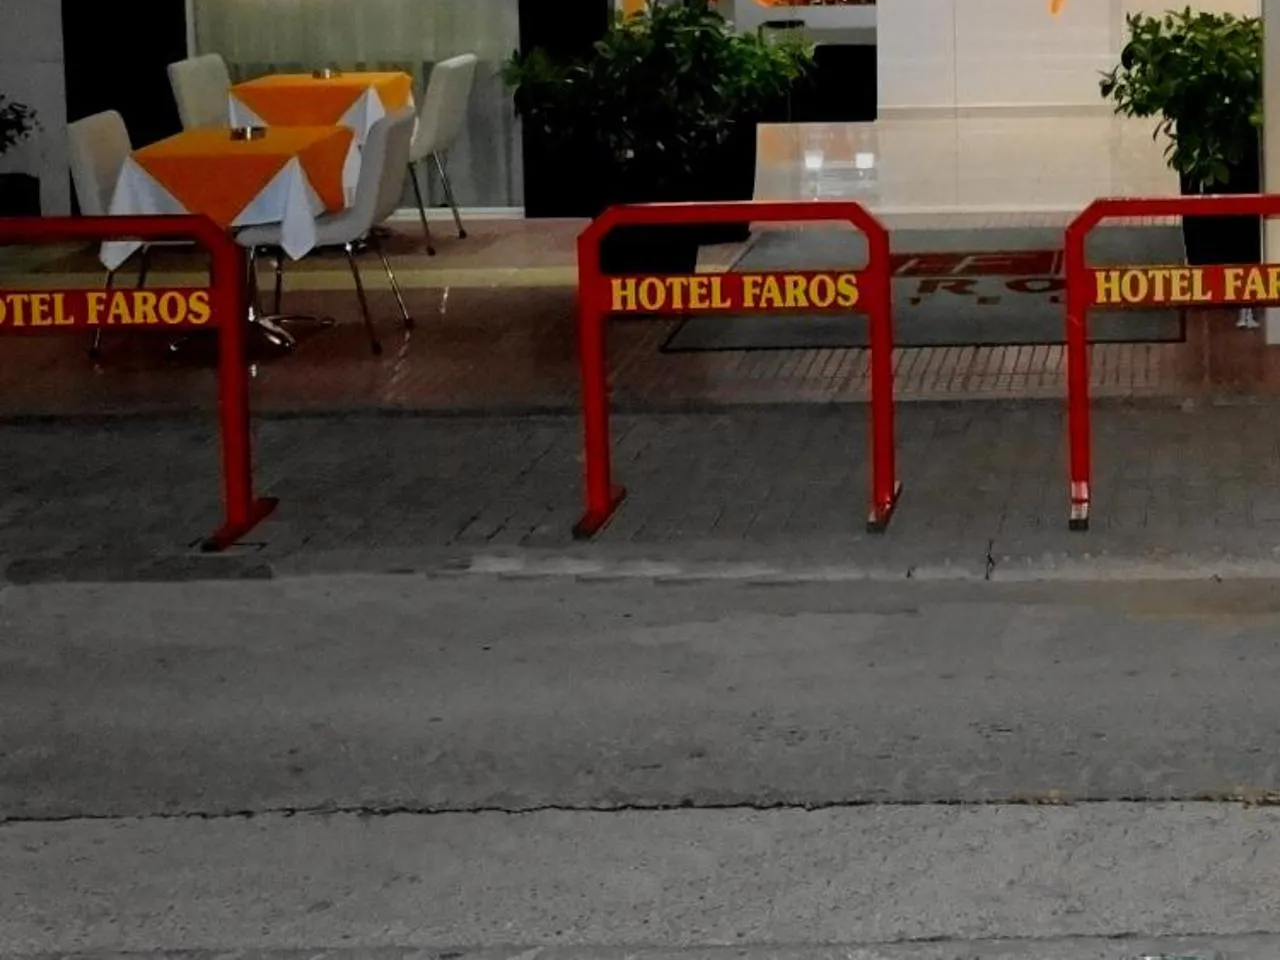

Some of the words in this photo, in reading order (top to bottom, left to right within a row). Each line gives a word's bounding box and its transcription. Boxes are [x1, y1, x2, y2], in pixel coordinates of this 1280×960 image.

[610, 276, 731, 310] HOTEL
[742, 273, 859, 308] FAROS
[1095, 269, 1212, 304] HOTEL
[0, 292, 75, 326] TEL
[86, 290, 212, 325] FAROS
